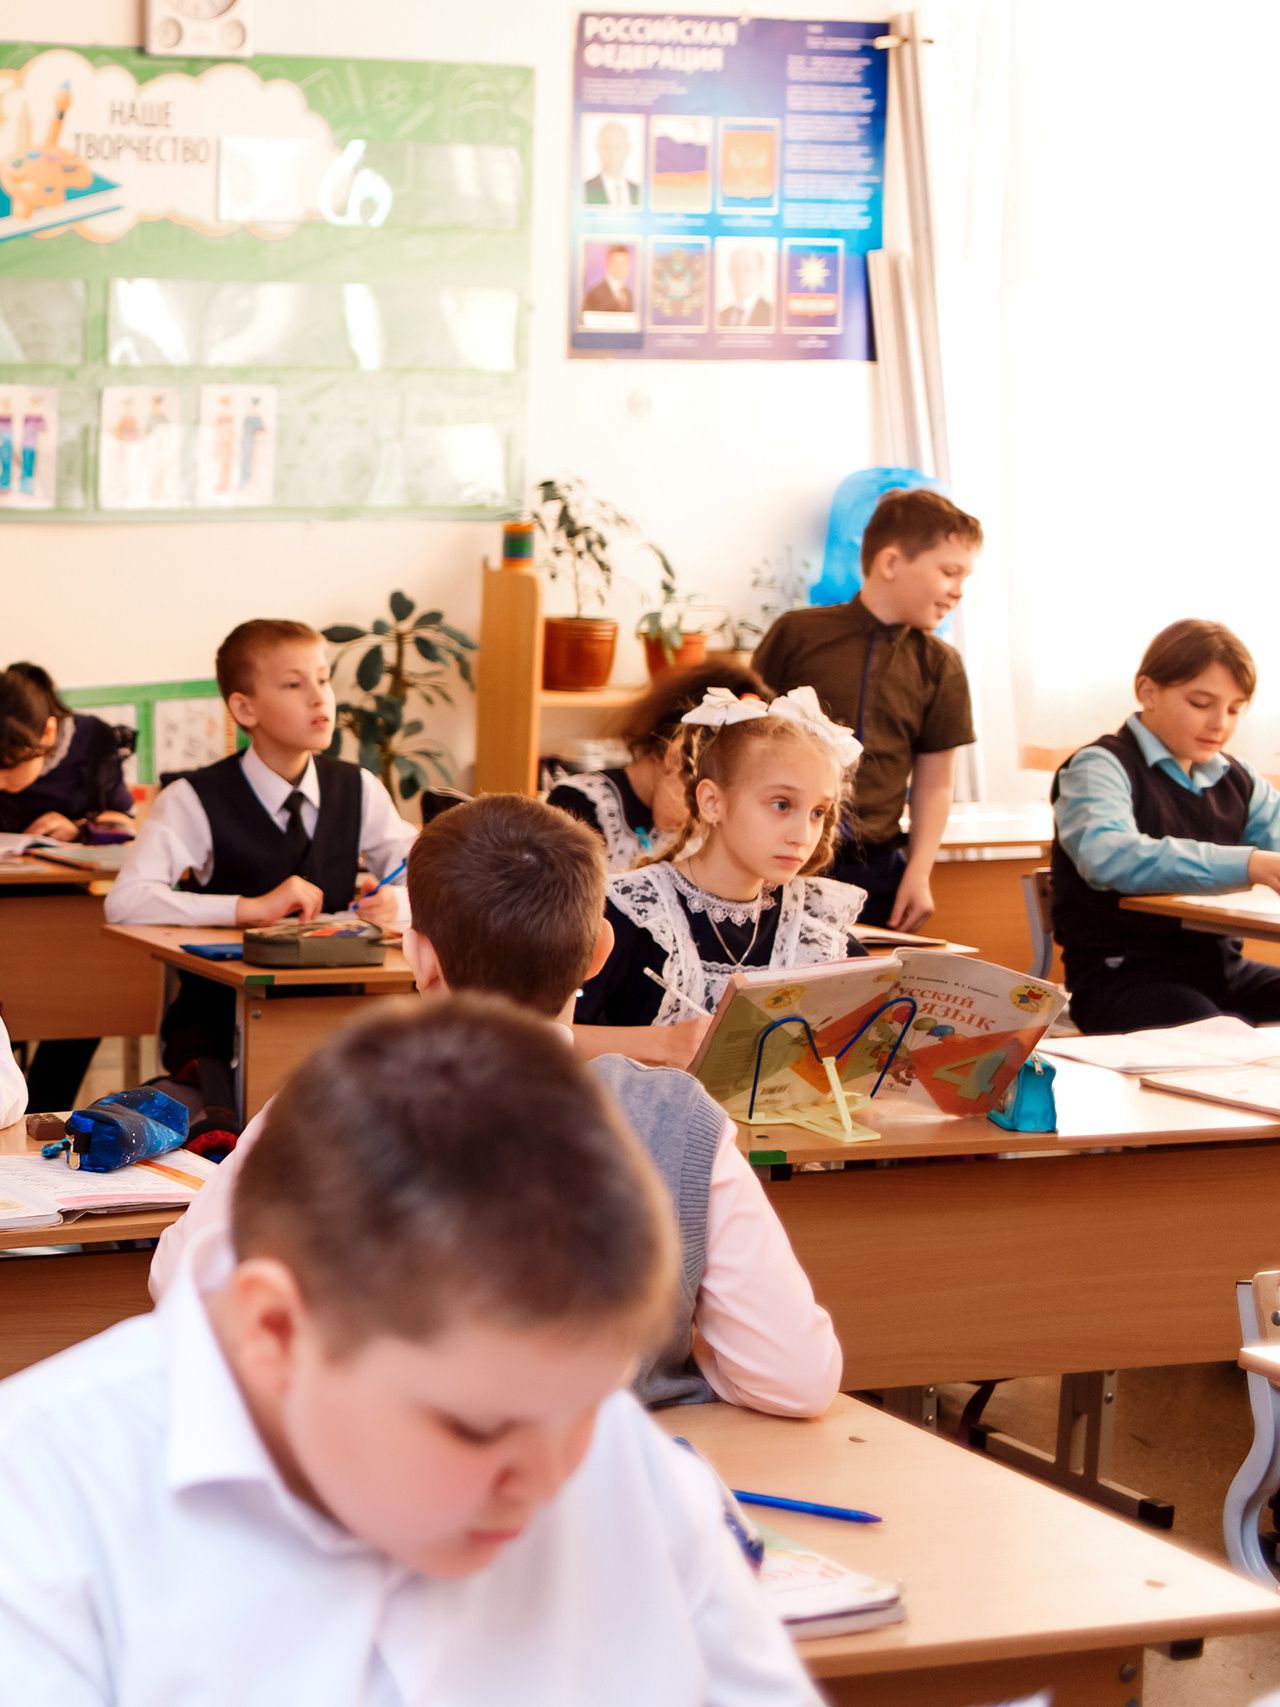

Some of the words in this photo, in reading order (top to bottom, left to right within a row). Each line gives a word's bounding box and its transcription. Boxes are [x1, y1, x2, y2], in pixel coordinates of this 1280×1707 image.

[584, 16, 738, 46] РОССИЙСКАЯ
[584, 42, 724, 74] ФЕДЕРАЦИЯ
[109, 99, 173, 128] НАШЕ
[73, 131, 210, 164] ТВОРЧЕСТВО
[932, 1049, 1007, 1101] 4
